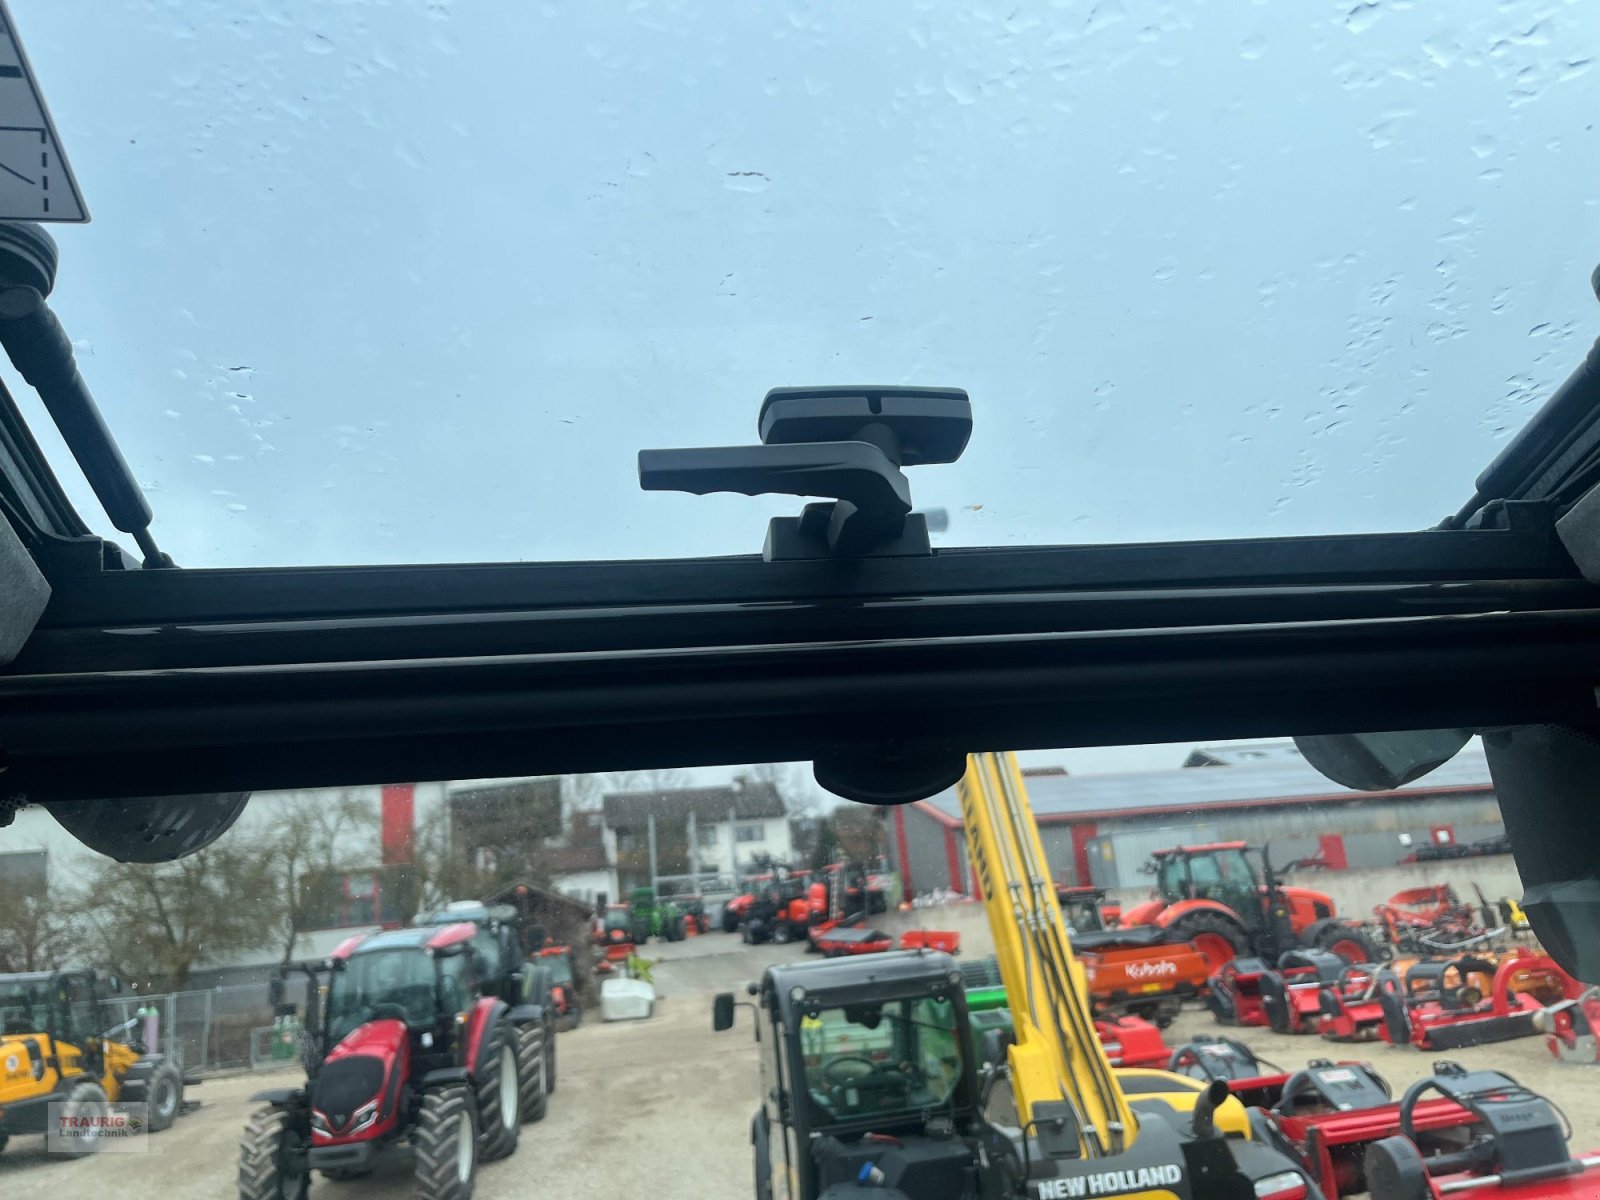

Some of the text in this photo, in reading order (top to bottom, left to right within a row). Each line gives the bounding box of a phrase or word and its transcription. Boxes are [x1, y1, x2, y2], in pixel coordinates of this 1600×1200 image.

[1125, 960, 1177, 979] Kubota
[1037, 1164, 1182, 1200] NEW HOLLAND
